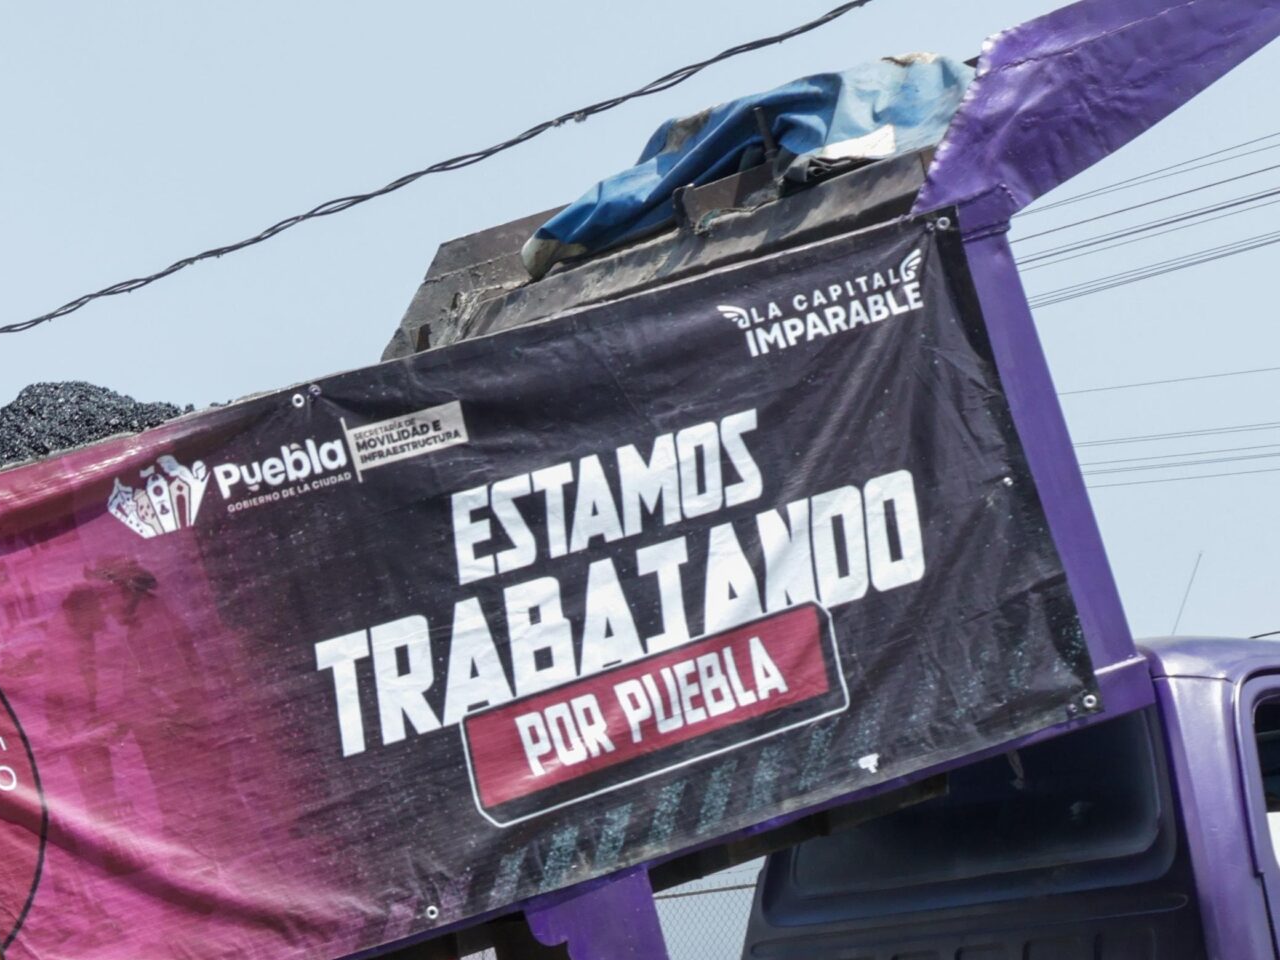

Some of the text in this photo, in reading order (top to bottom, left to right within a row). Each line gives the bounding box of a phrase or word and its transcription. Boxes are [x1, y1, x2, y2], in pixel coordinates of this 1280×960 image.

[745, 281, 924, 357] IMPARABLE
[751, 269, 900, 323] LA CAPITAL
[354, 418, 416, 440] SECRETARÍA DE
[356, 419, 442, 452] MOVILIDAD E
[360, 429, 462, 464] INFRAESTRUCTURA
[213, 438, 347, 499] Puebla
[227, 472, 352, 513] GOBIERNO DE LA CIUDAD
[450, 408, 764, 586] ESTAMOS
[314, 469, 925, 757] TRABAJANDO
[514, 636, 789, 778] POR PUEBLA
